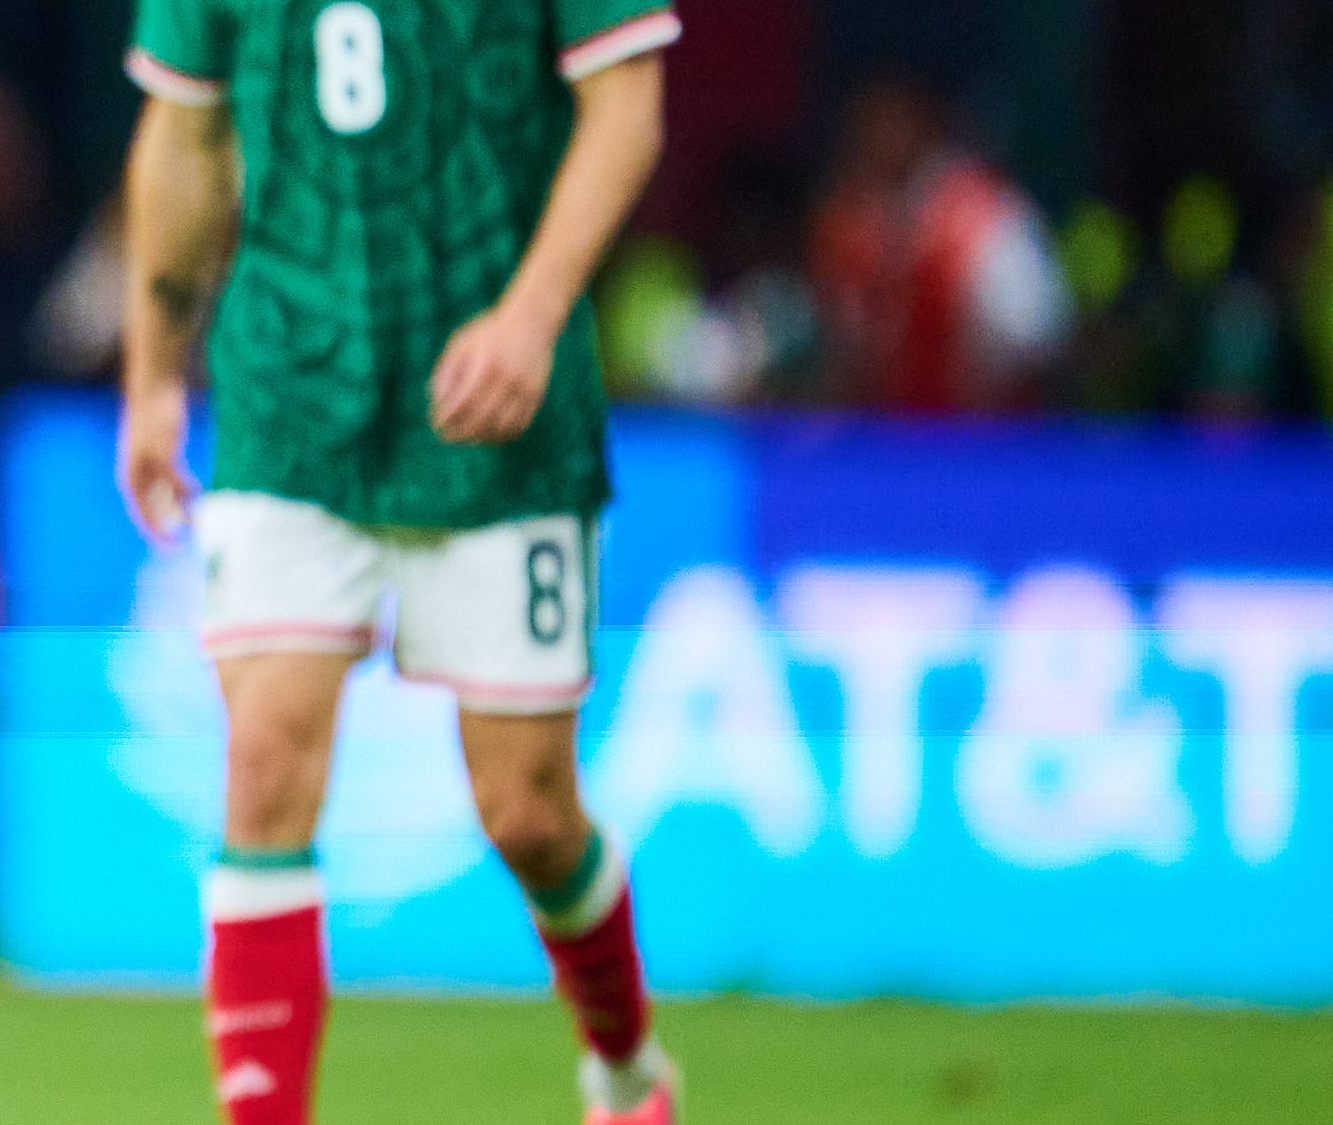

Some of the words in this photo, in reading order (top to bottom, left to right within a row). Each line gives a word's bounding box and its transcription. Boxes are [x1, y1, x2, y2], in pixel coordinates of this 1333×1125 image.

[315, 1, 386, 133] 8
[527, 539, 565, 645] 8
[579, 563, 1333, 867] AT&T
